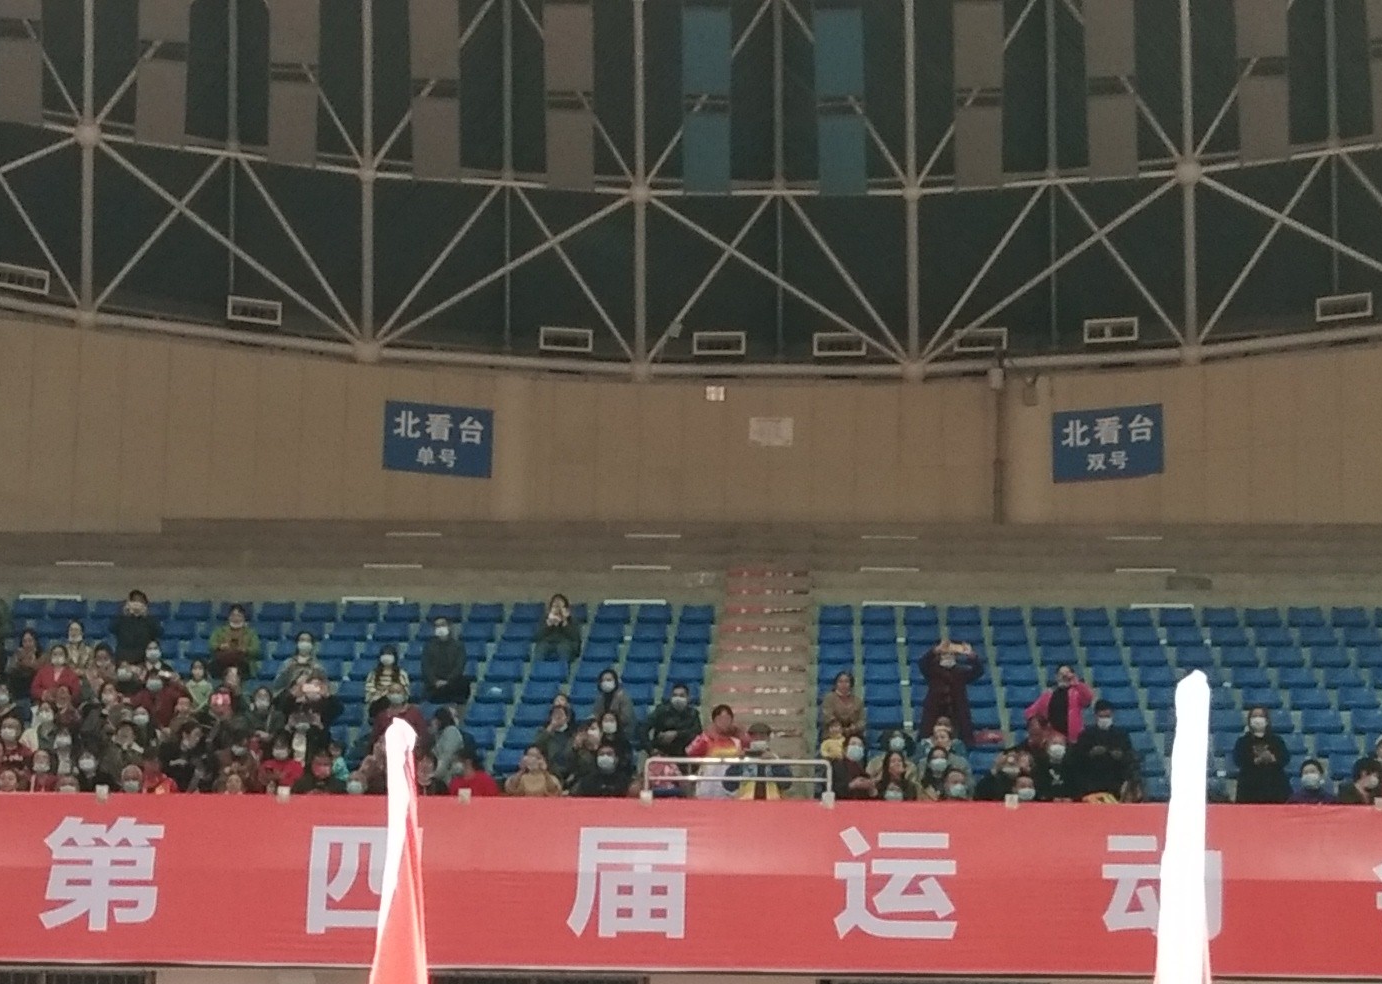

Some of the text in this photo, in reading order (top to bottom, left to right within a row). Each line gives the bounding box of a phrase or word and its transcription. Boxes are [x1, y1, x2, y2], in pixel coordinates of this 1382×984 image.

[394, 410, 484, 445] 北看台
[1061, 413, 1156, 448] 北看台
[416, 446, 457, 468] 单号
[1087, 451, 1129, 471] 双号
